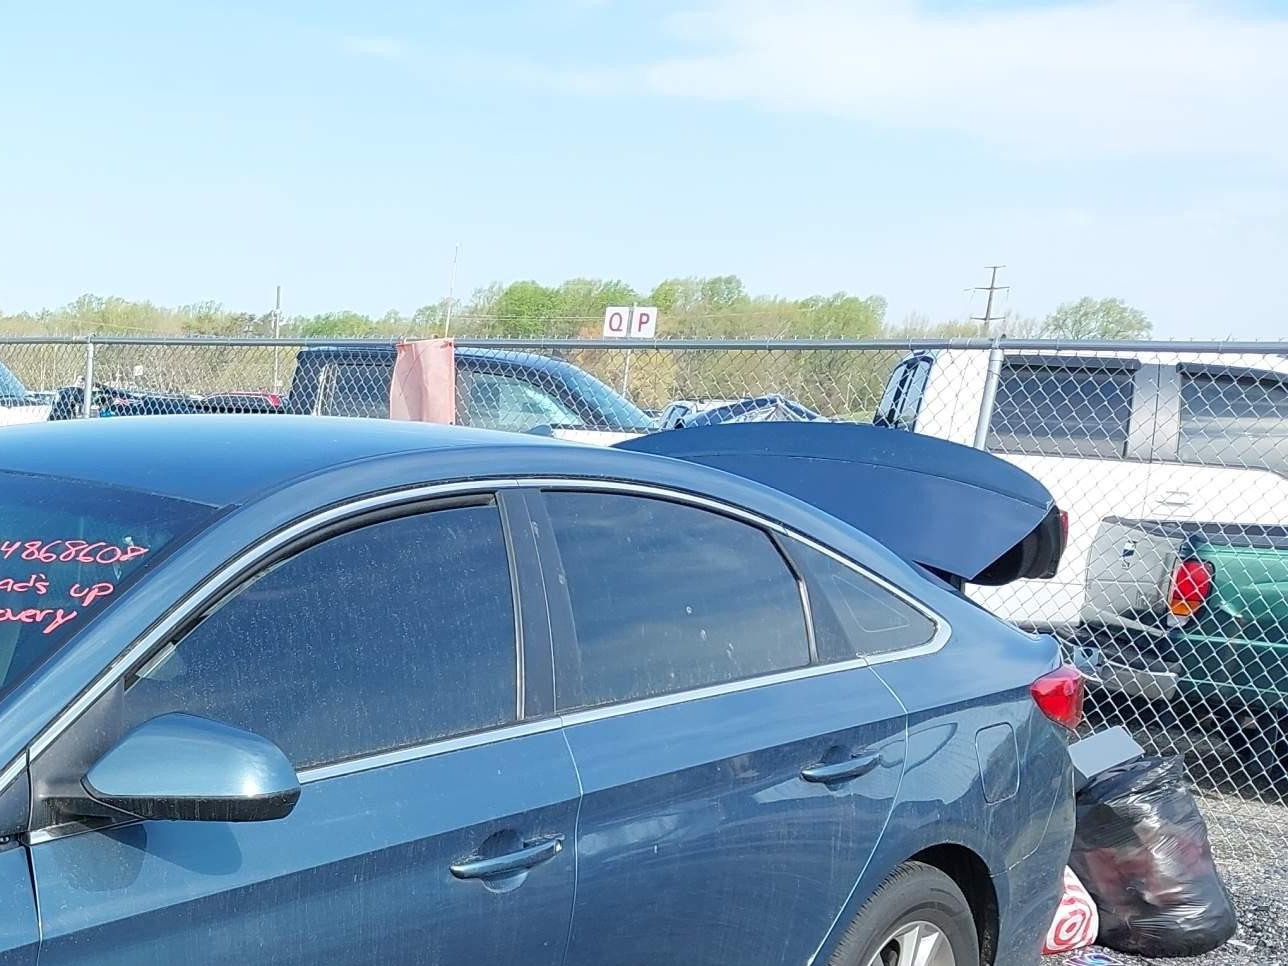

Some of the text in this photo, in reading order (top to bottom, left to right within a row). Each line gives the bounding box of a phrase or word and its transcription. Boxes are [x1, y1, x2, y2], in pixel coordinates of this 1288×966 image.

[608, 312, 623, 332] Q
[638, 312, 650, 332] P
[70, 582, 114, 606] up
